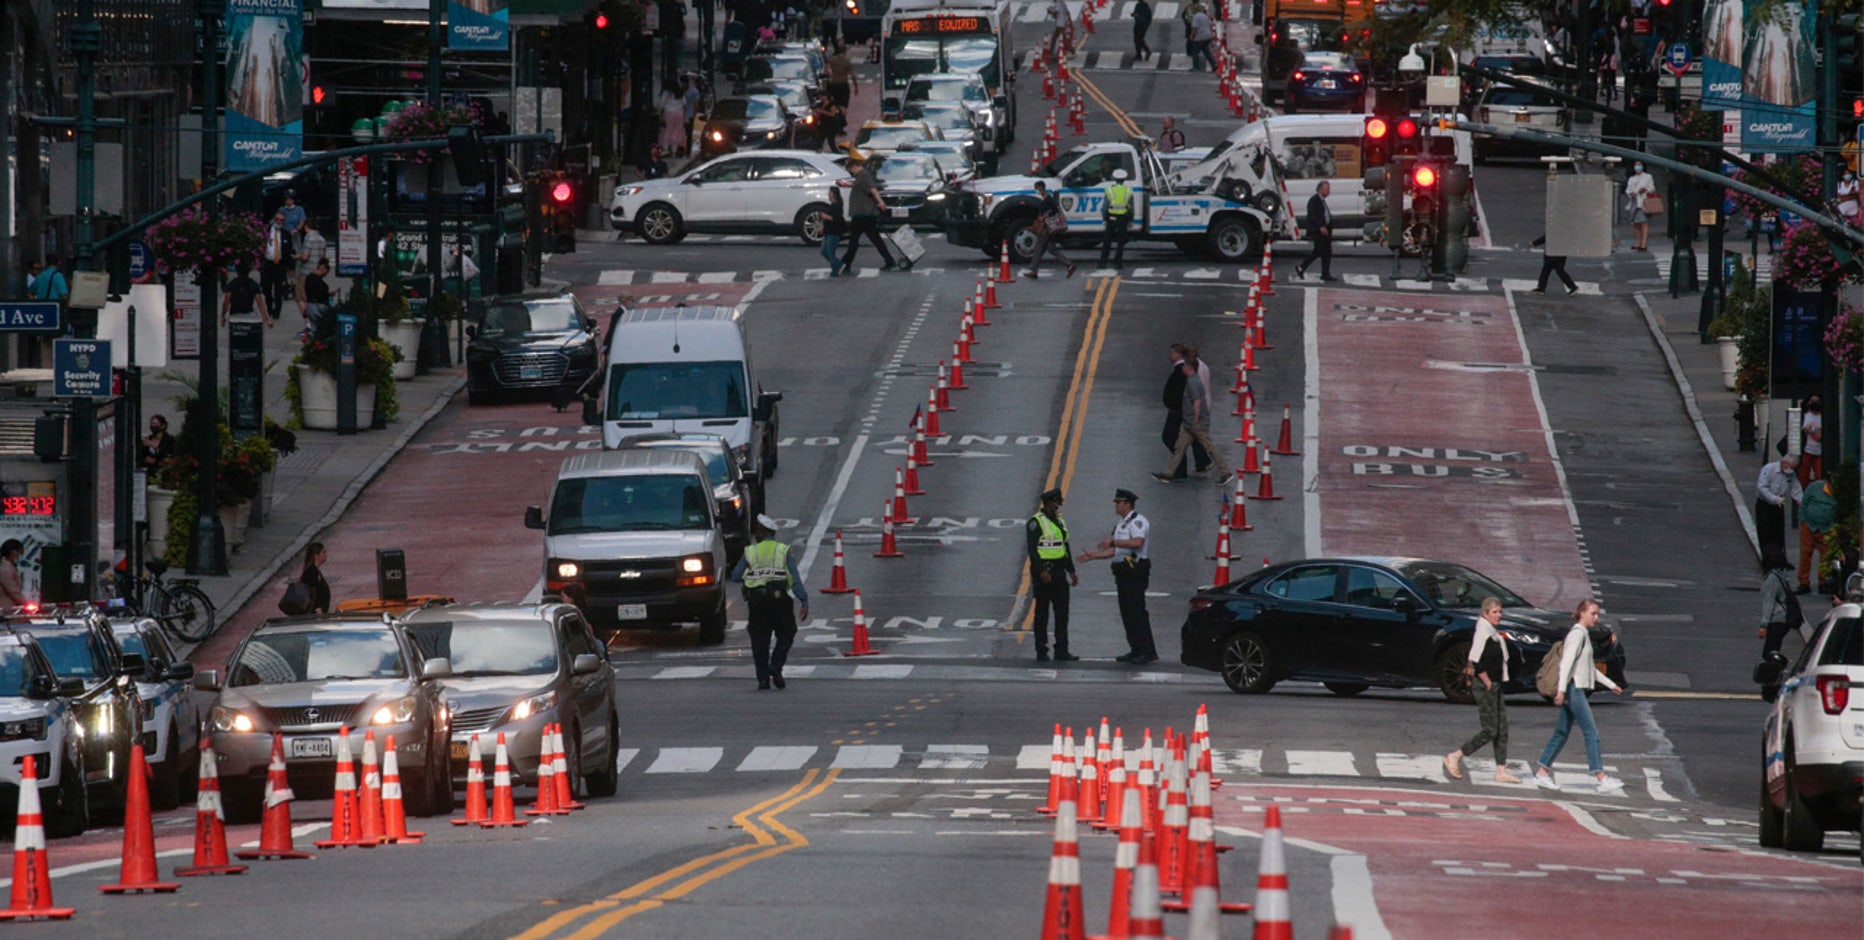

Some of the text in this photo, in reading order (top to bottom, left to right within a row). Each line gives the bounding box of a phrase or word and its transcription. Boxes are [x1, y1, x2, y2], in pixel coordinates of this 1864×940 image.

[230, 0, 298, 9] FINANCIAL
[1709, 82, 1742, 92] CANTO
[1749, 123, 1793, 132] CANTOR
[233, 140, 279, 151] CANTOR
[397, 231, 422, 242] Grand
[12, 309, 44, 324] Ave
[344, 323, 354, 336] P
[69, 343, 97, 353] NYPD
[64, 371, 101, 382] Security
[65, 380, 101, 389] Camera
[1342, 445, 1520, 462] ONLY
[1353, 463, 1510, 478] BUS
